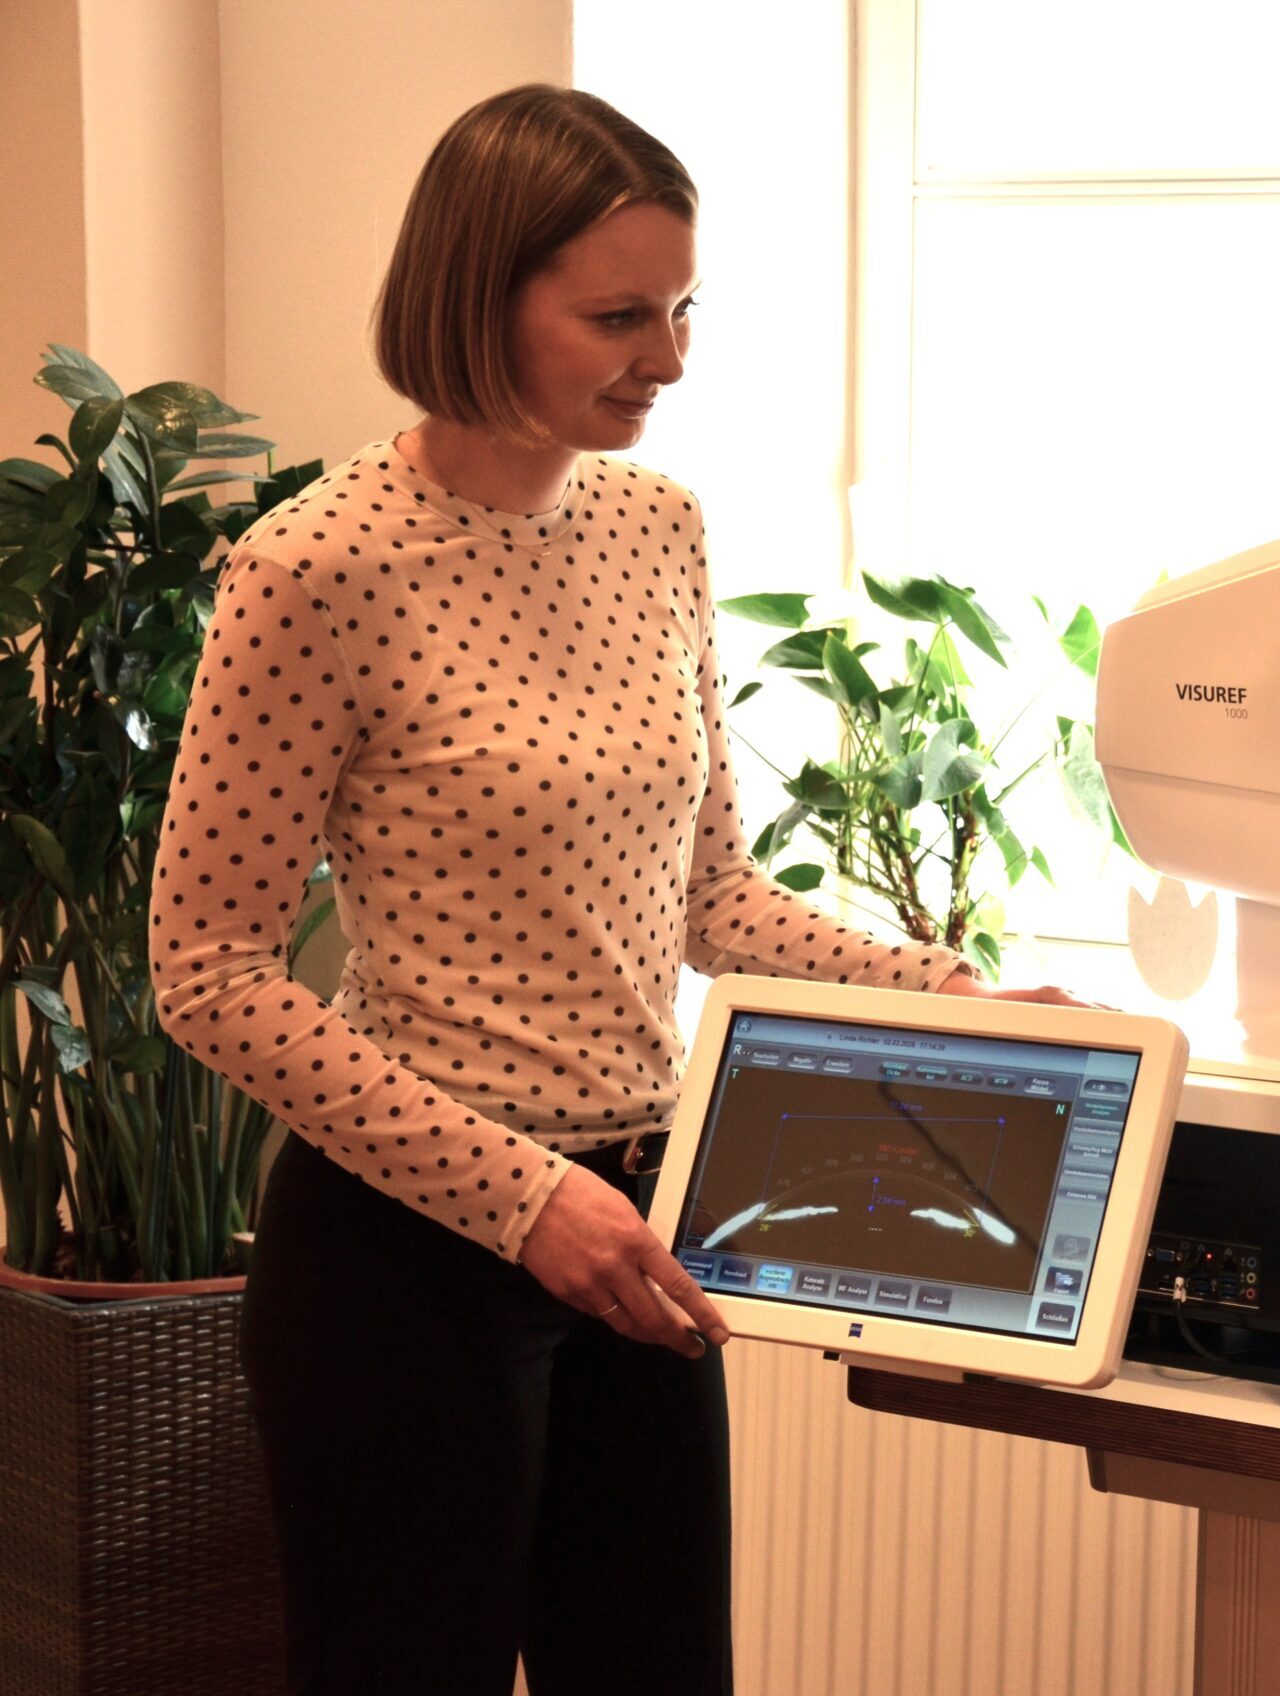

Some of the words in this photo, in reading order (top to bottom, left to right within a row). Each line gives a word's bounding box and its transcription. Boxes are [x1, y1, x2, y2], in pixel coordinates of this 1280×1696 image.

[1175, 683, 1247, 704] VISUREF
[1225, 707, 1248, 719] 1000
[731, 1068, 740, 1079] T
[960, 1074, 974, 1082] ACD
[1056, 1104, 1066, 1115] N
[879, 1290, 907, 1300] Simulation
[923, 1296, 943, 1305] Fundus
[1042, 1313, 1069, 1323] Schließen
